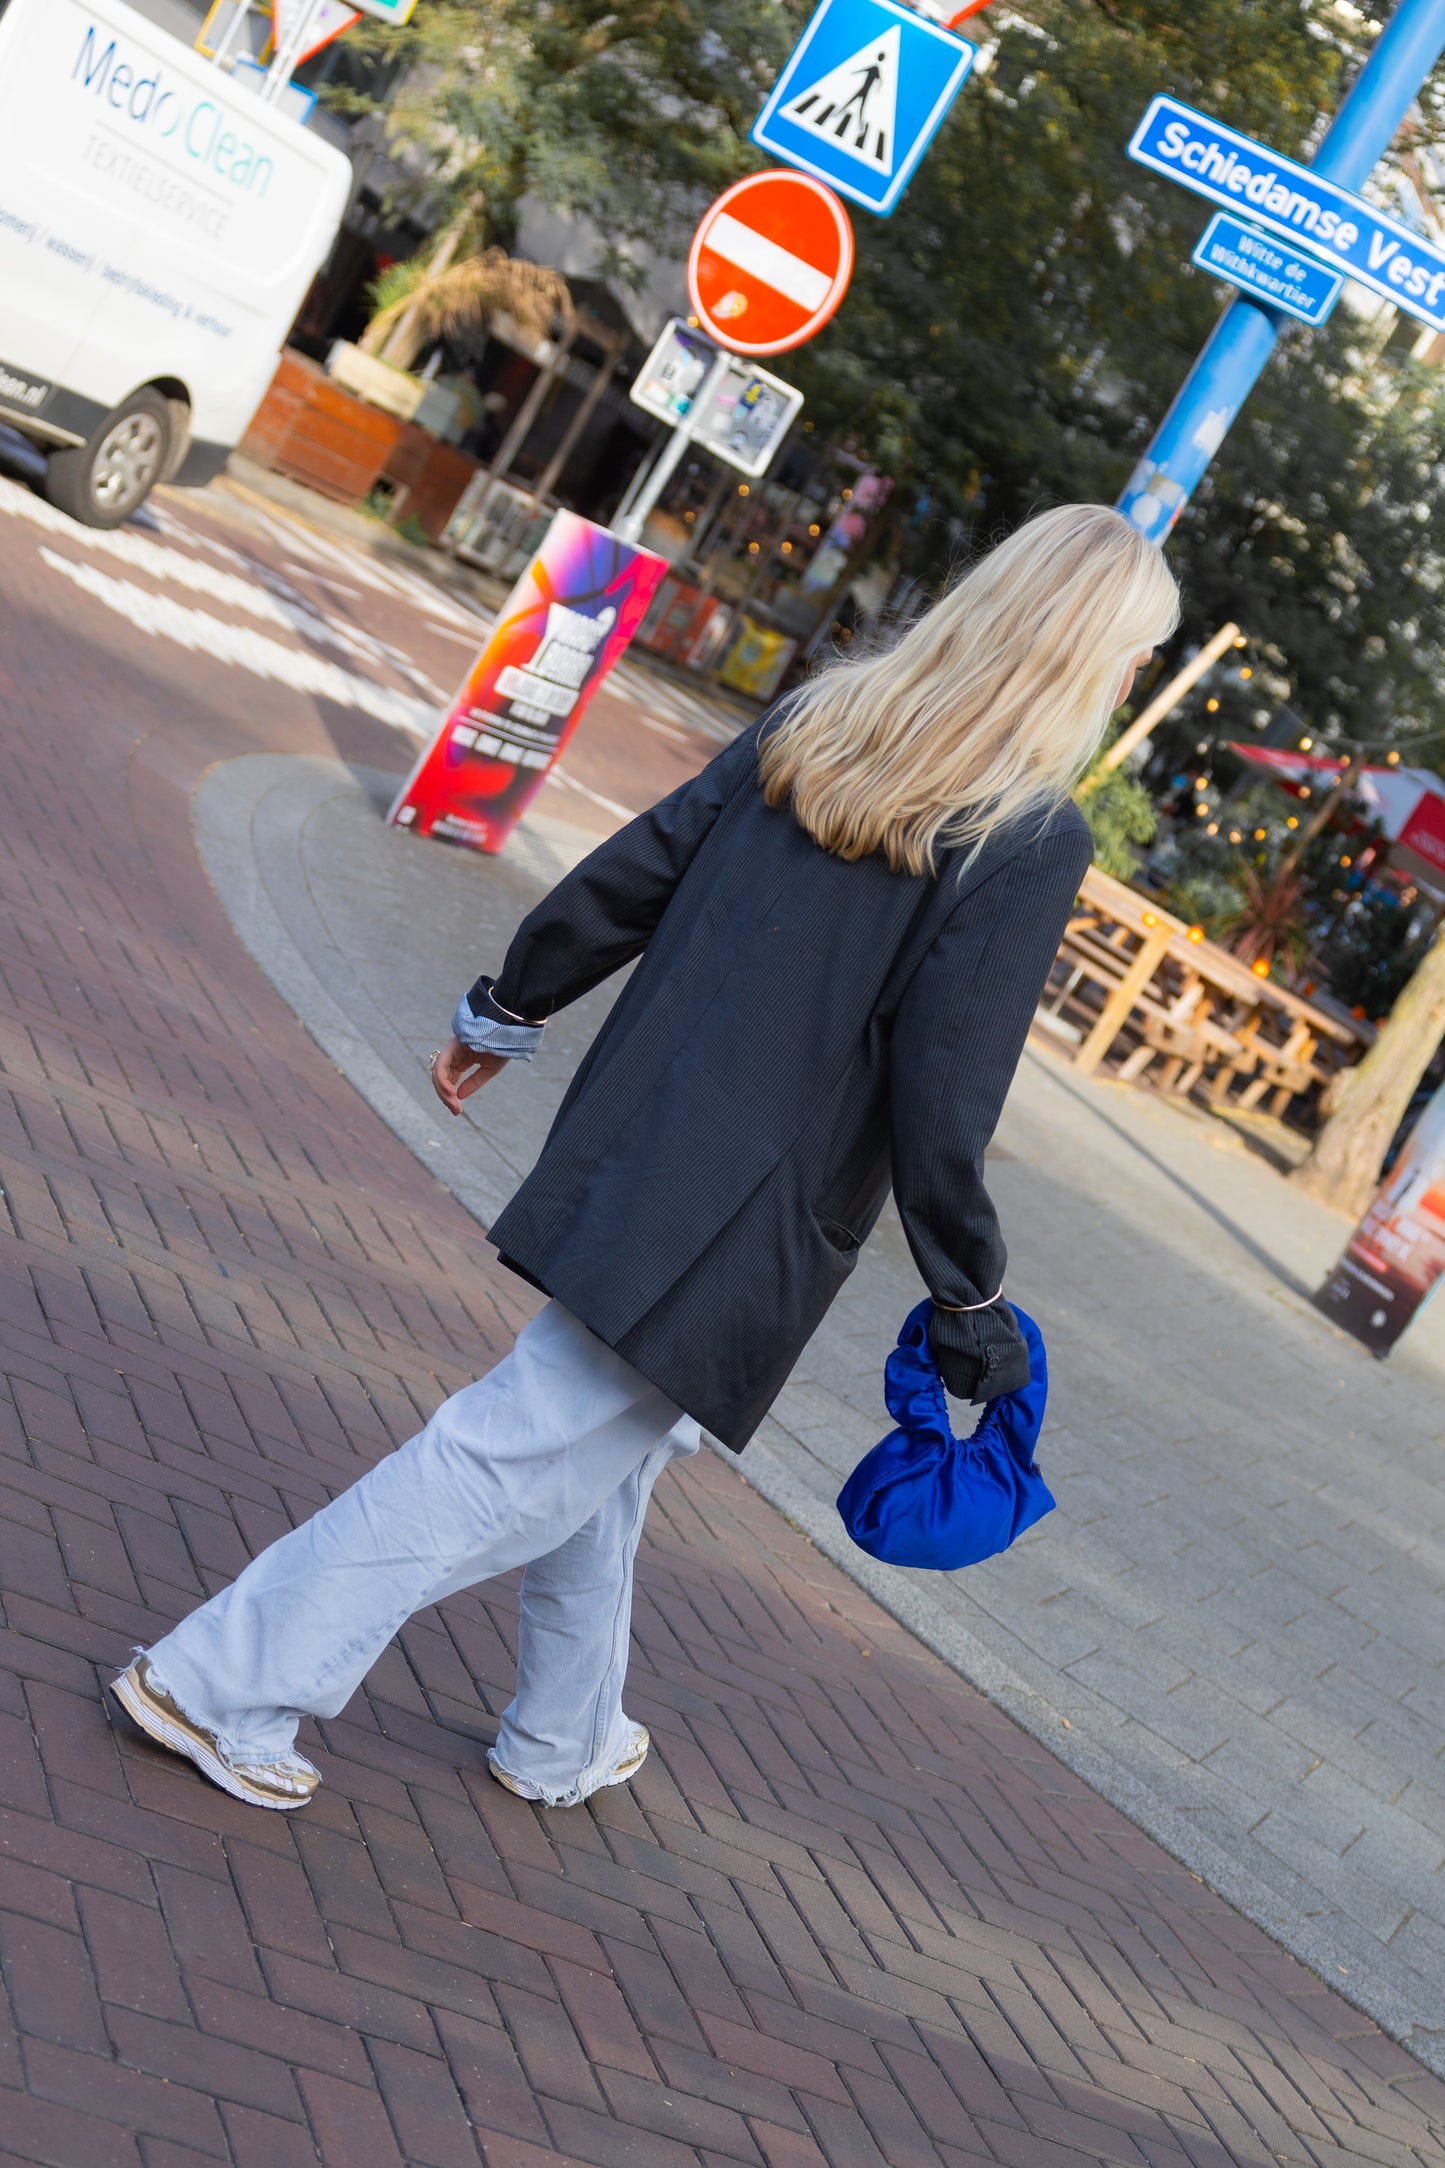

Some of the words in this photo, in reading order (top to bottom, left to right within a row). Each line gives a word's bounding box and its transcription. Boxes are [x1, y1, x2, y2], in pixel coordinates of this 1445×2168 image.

[1156, 121, 1359, 251] Schiedamse
[1367, 230, 1445, 307] Vest
[1210, 243, 1317, 309] Withkwartier
[1238, 234, 1284, 271] Witte
[1285, 255, 1308, 283] de
